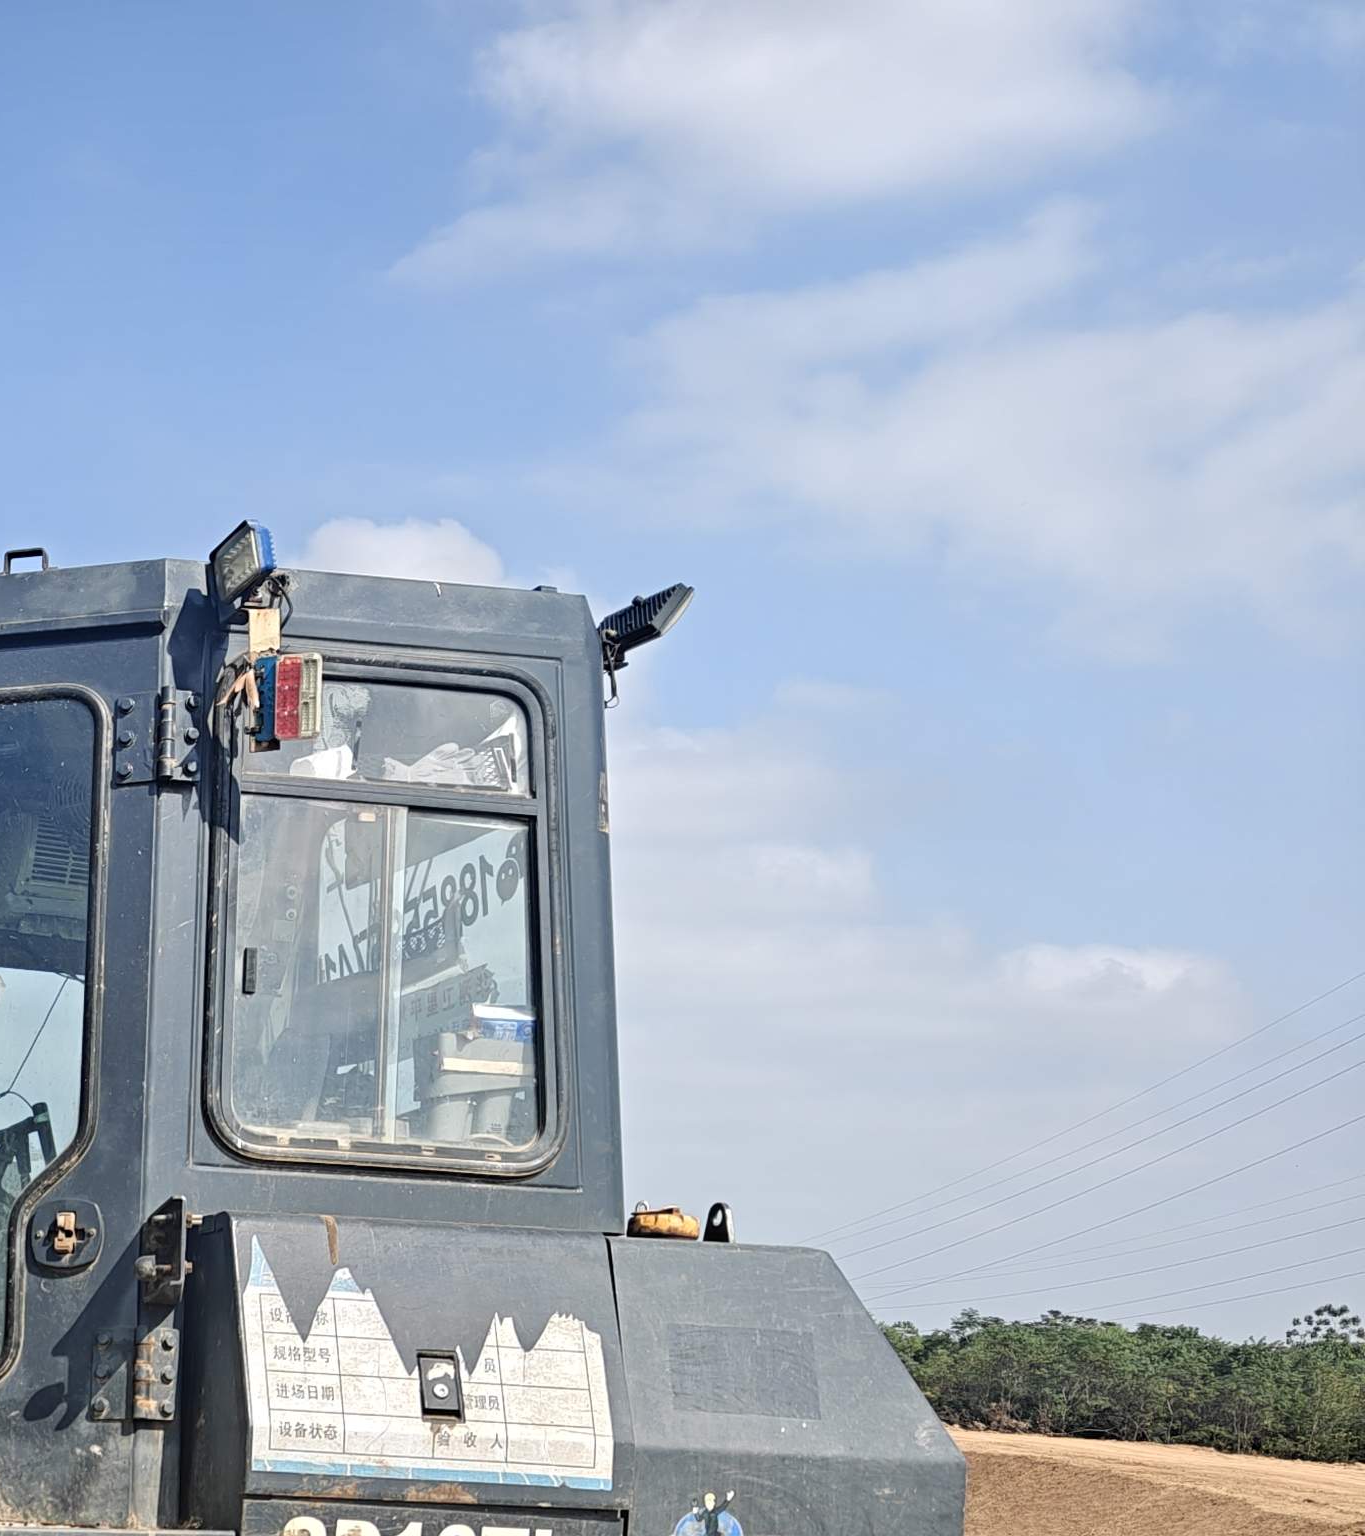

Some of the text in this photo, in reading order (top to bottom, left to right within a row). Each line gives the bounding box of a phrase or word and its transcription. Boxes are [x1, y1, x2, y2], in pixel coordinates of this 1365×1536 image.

[273, 1345, 332, 1364] 规格型号
[276, 1382, 336, 1401] 进场日期
[278, 1420, 338, 1440] 设备状态
